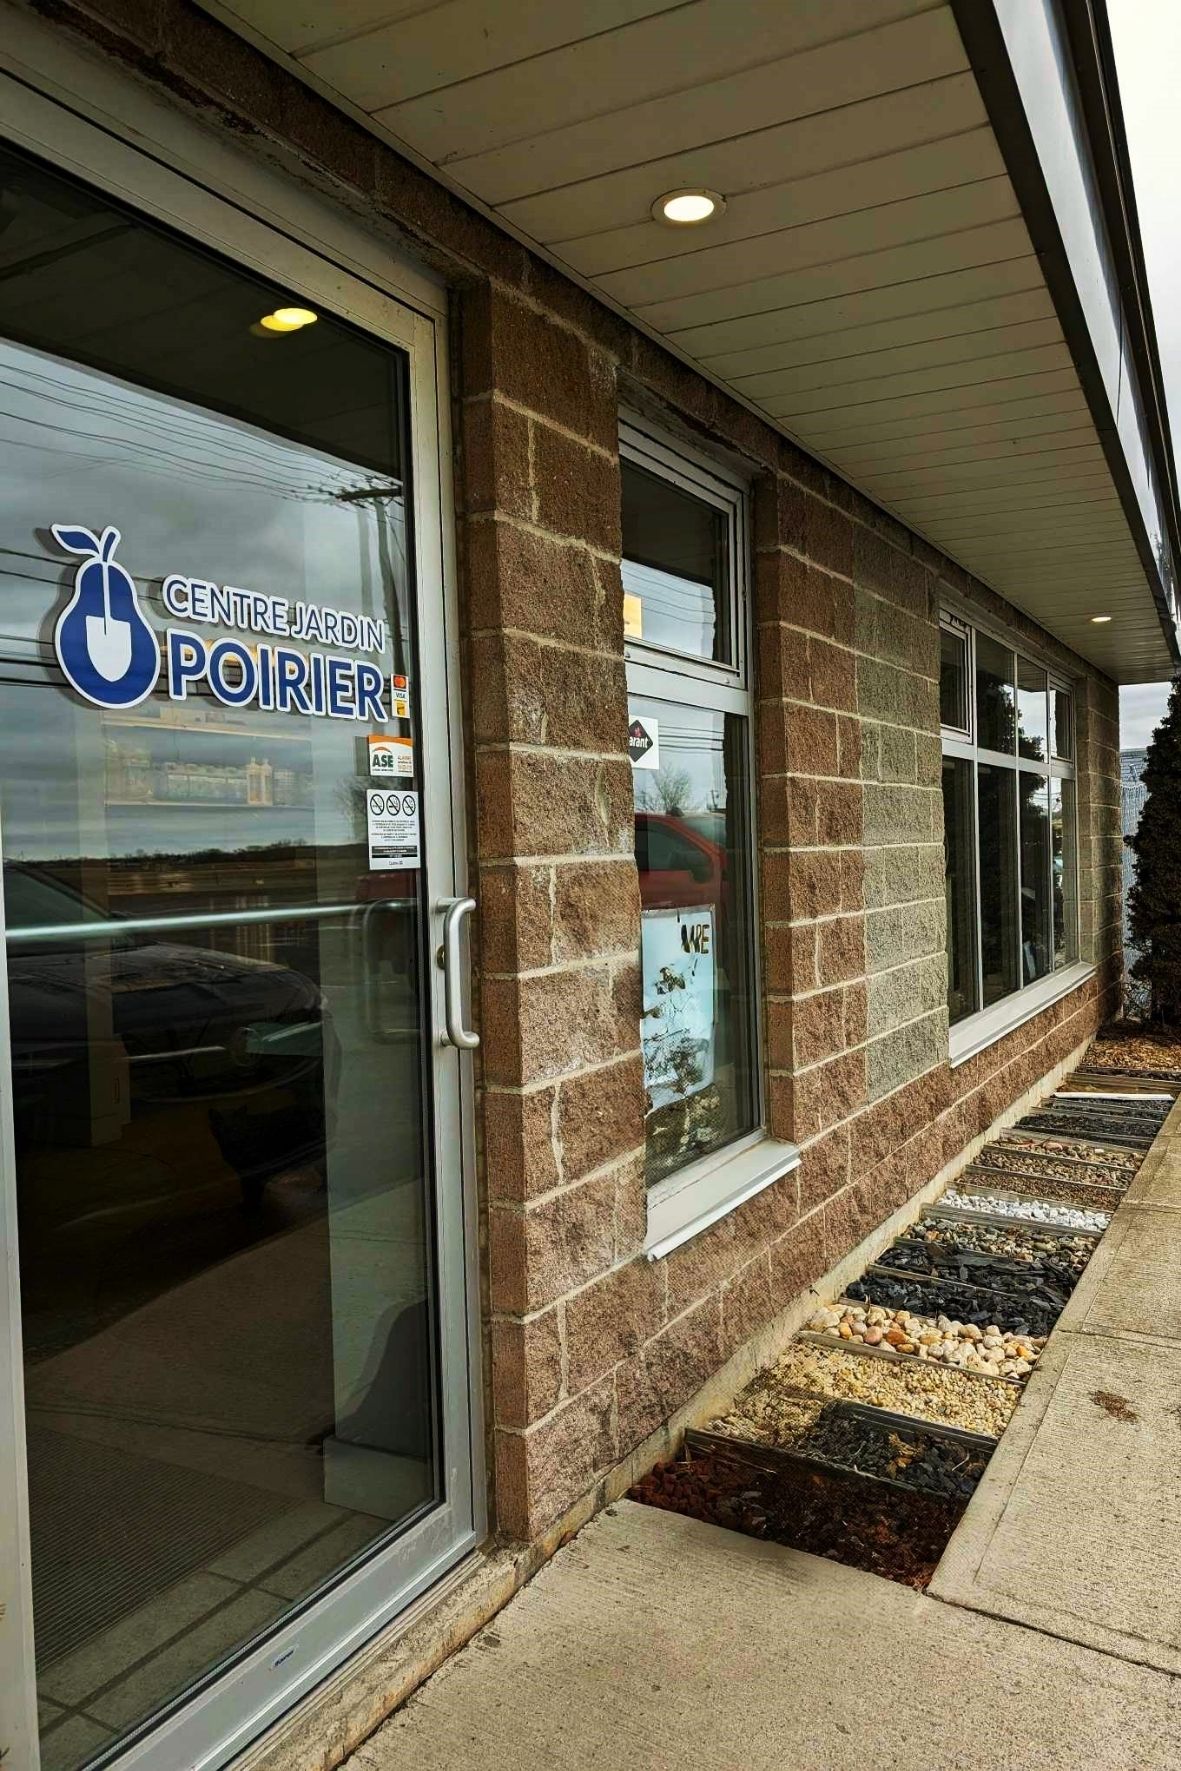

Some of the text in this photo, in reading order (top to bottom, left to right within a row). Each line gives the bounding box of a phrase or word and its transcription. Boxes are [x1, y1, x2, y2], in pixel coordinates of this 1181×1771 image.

[165, 577, 384, 651] CENTRE JARDIN
[170, 632, 386, 720] POIRIER
[372, 754, 394, 768] ASE
[629, 736, 648, 748] arant
